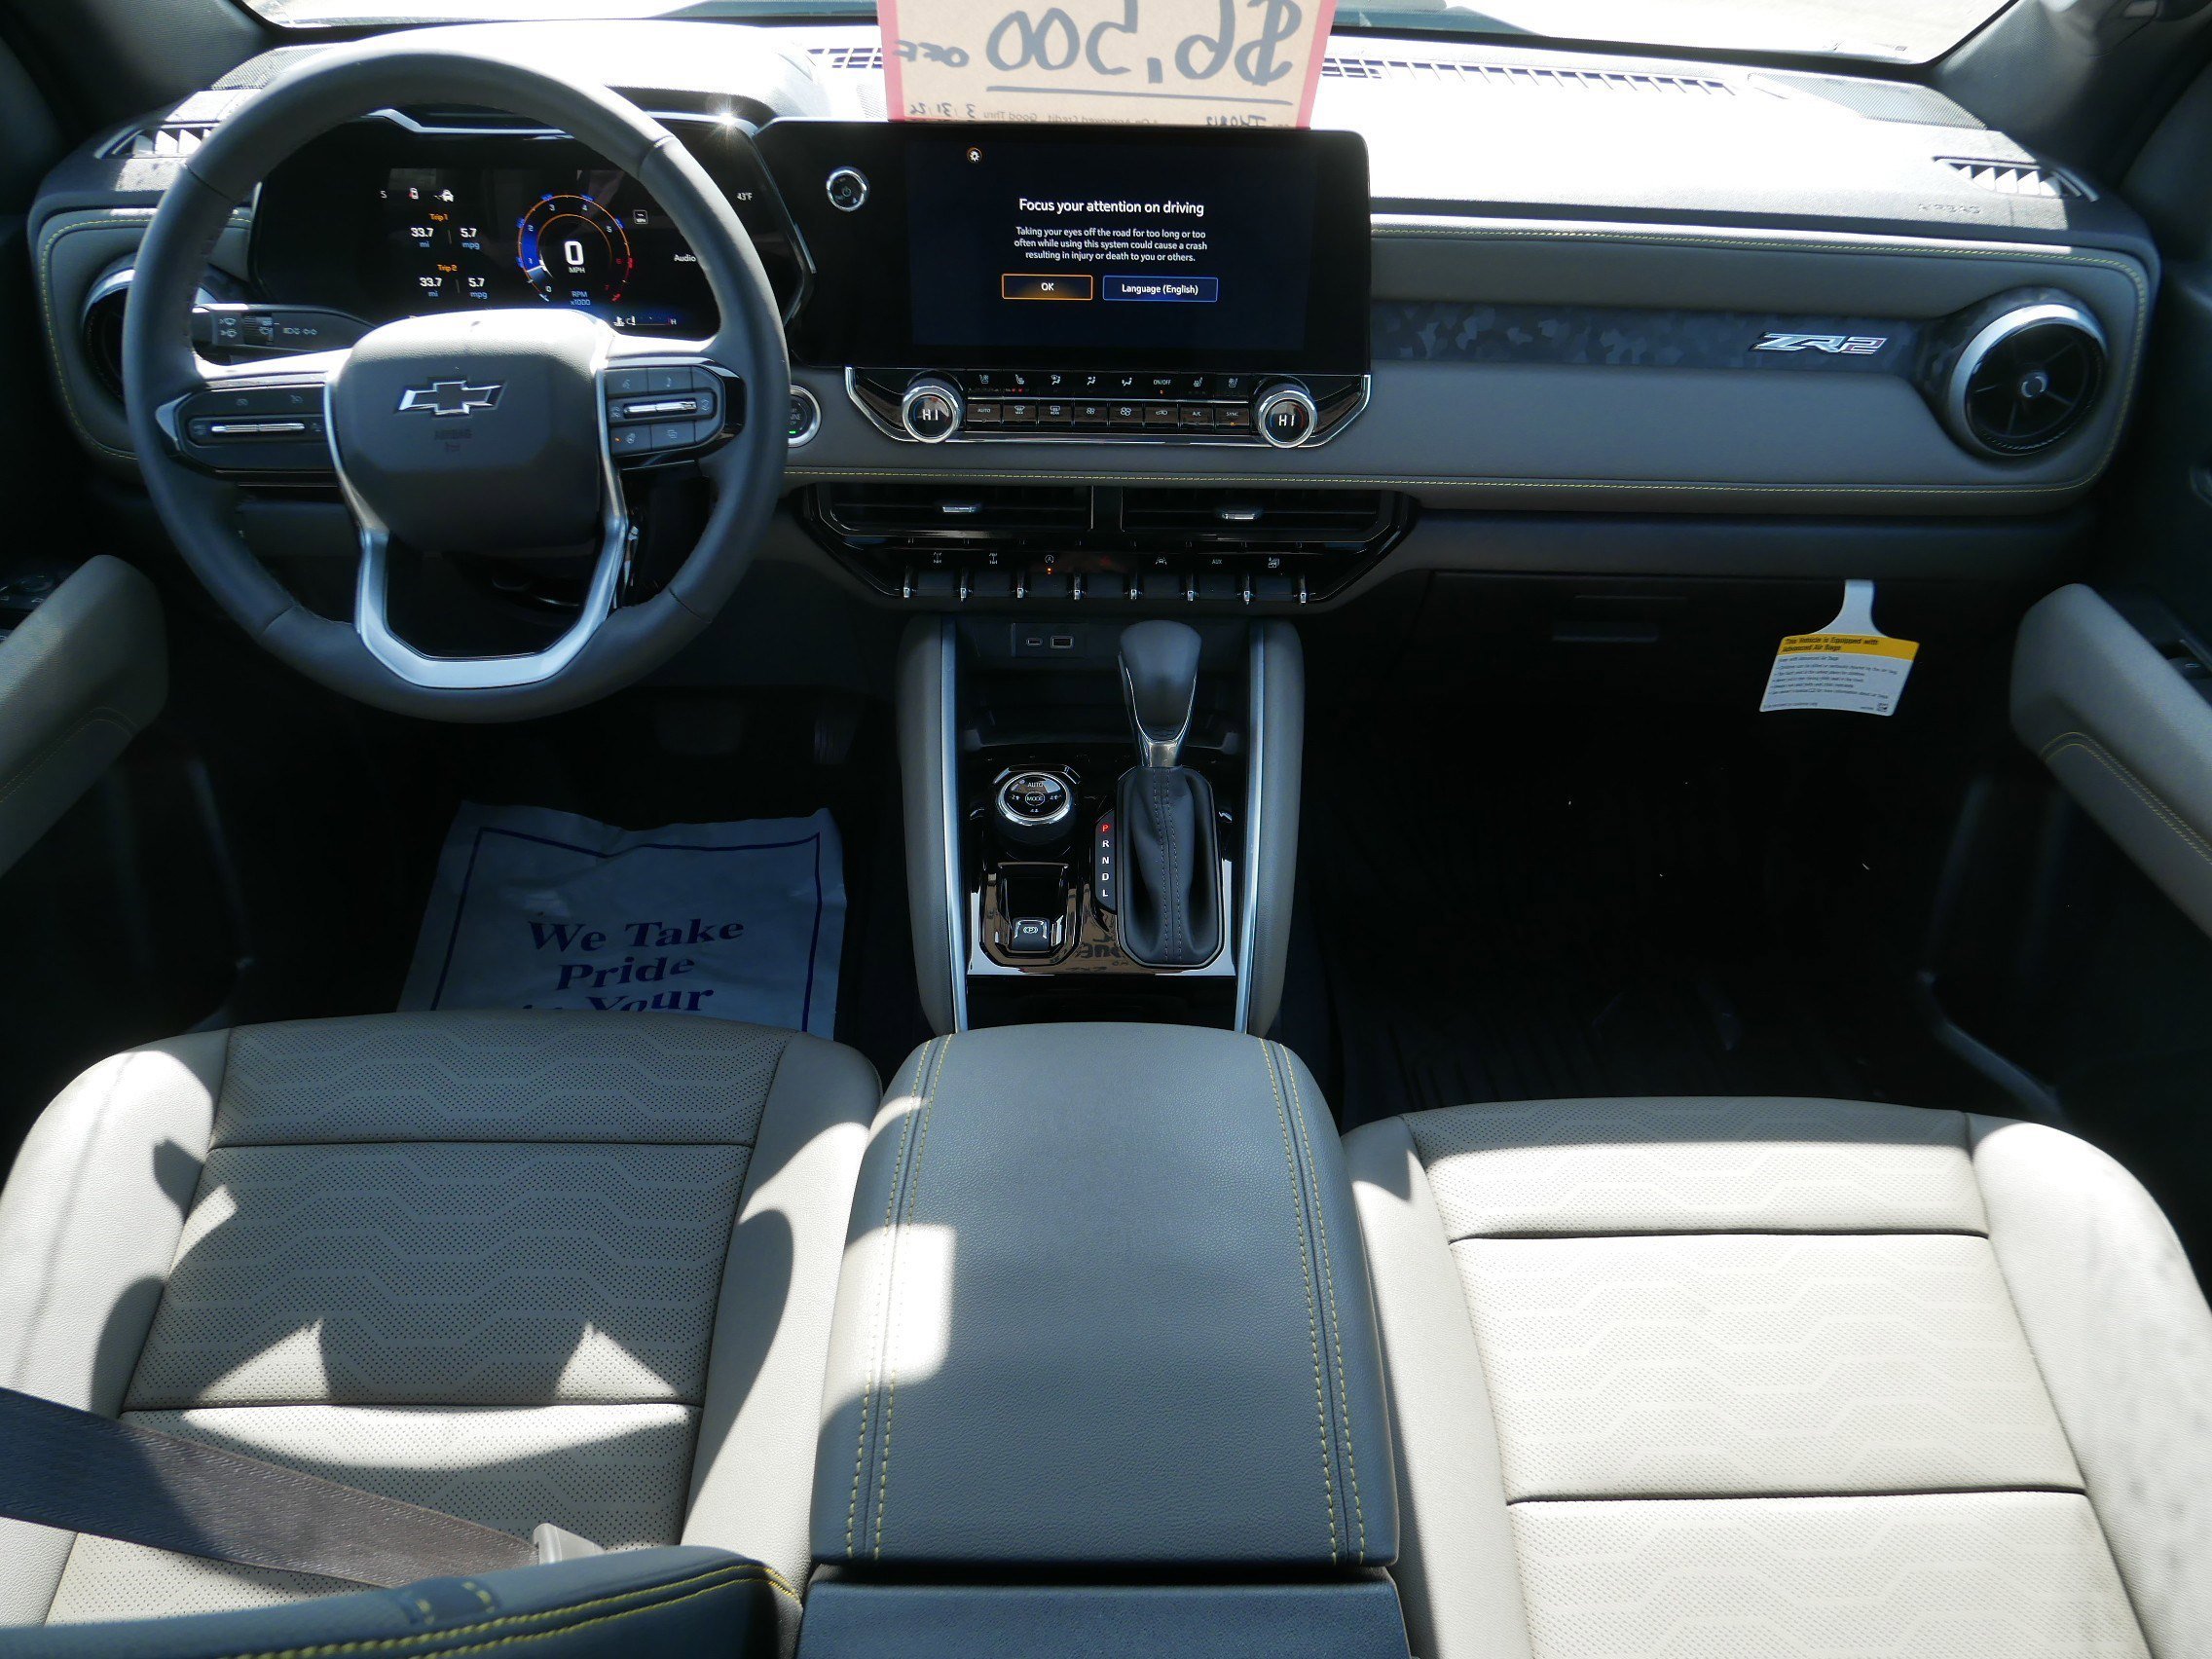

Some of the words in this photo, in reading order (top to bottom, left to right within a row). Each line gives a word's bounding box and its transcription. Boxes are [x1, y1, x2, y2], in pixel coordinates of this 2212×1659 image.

[1019, 199, 1054, 211] Focus
[1057, 201, 1084, 214] your
[1087, 201, 1141, 213] attention
[1144, 203, 1161, 213] on
[1163, 201, 1204, 217] driving
[411, 227, 434, 238] 33.7
[461, 228, 477, 238] 5.7
[1016, 227, 1043, 238] Taking
[1044, 229, 1062, 238] your
[1064, 230, 1082, 239] eyes
[1084, 228, 1096, 237] off
[1097, 228, 1111, 237] the
[1112, 229, 1131, 238] road
[1132, 229, 1145, 238] for
[1161, 229, 1179, 240] long
[461, 241, 480, 250] mpg
[1014, 239, 1036, 248] often
[1038, 240, 1059, 248] while
[1060, 240, 1082, 250] using
[1100, 240, 1128, 251] system
[1130, 240, 1153, 249] could
[1186, 241, 1207, 250] crash
[564, 240, 584, 266] 0
[673, 254, 697, 263] Audio
[1025, 251, 1060, 262] resulting
[1071, 251, 1093, 262] injury
[1106, 251, 1128, 260] death
[1139, 254, 1156, 263] you
[1167, 253, 1196, 262] others.
[419, 277, 443, 287] 33.7
[468, 277, 486, 287] 5.7
[1041, 282, 1053, 291] OK
[1122, 284, 1161, 294] Language
[1162, 284, 1198, 295] (English)
[470, 291, 489, 300] mpg
[1749, 331, 1889, 355] ZR2
[1102, 872, 1109, 881] D
[527, 920, 607, 952] We
[624, 918, 744, 947] Take
[555, 955, 695, 991] Pride
